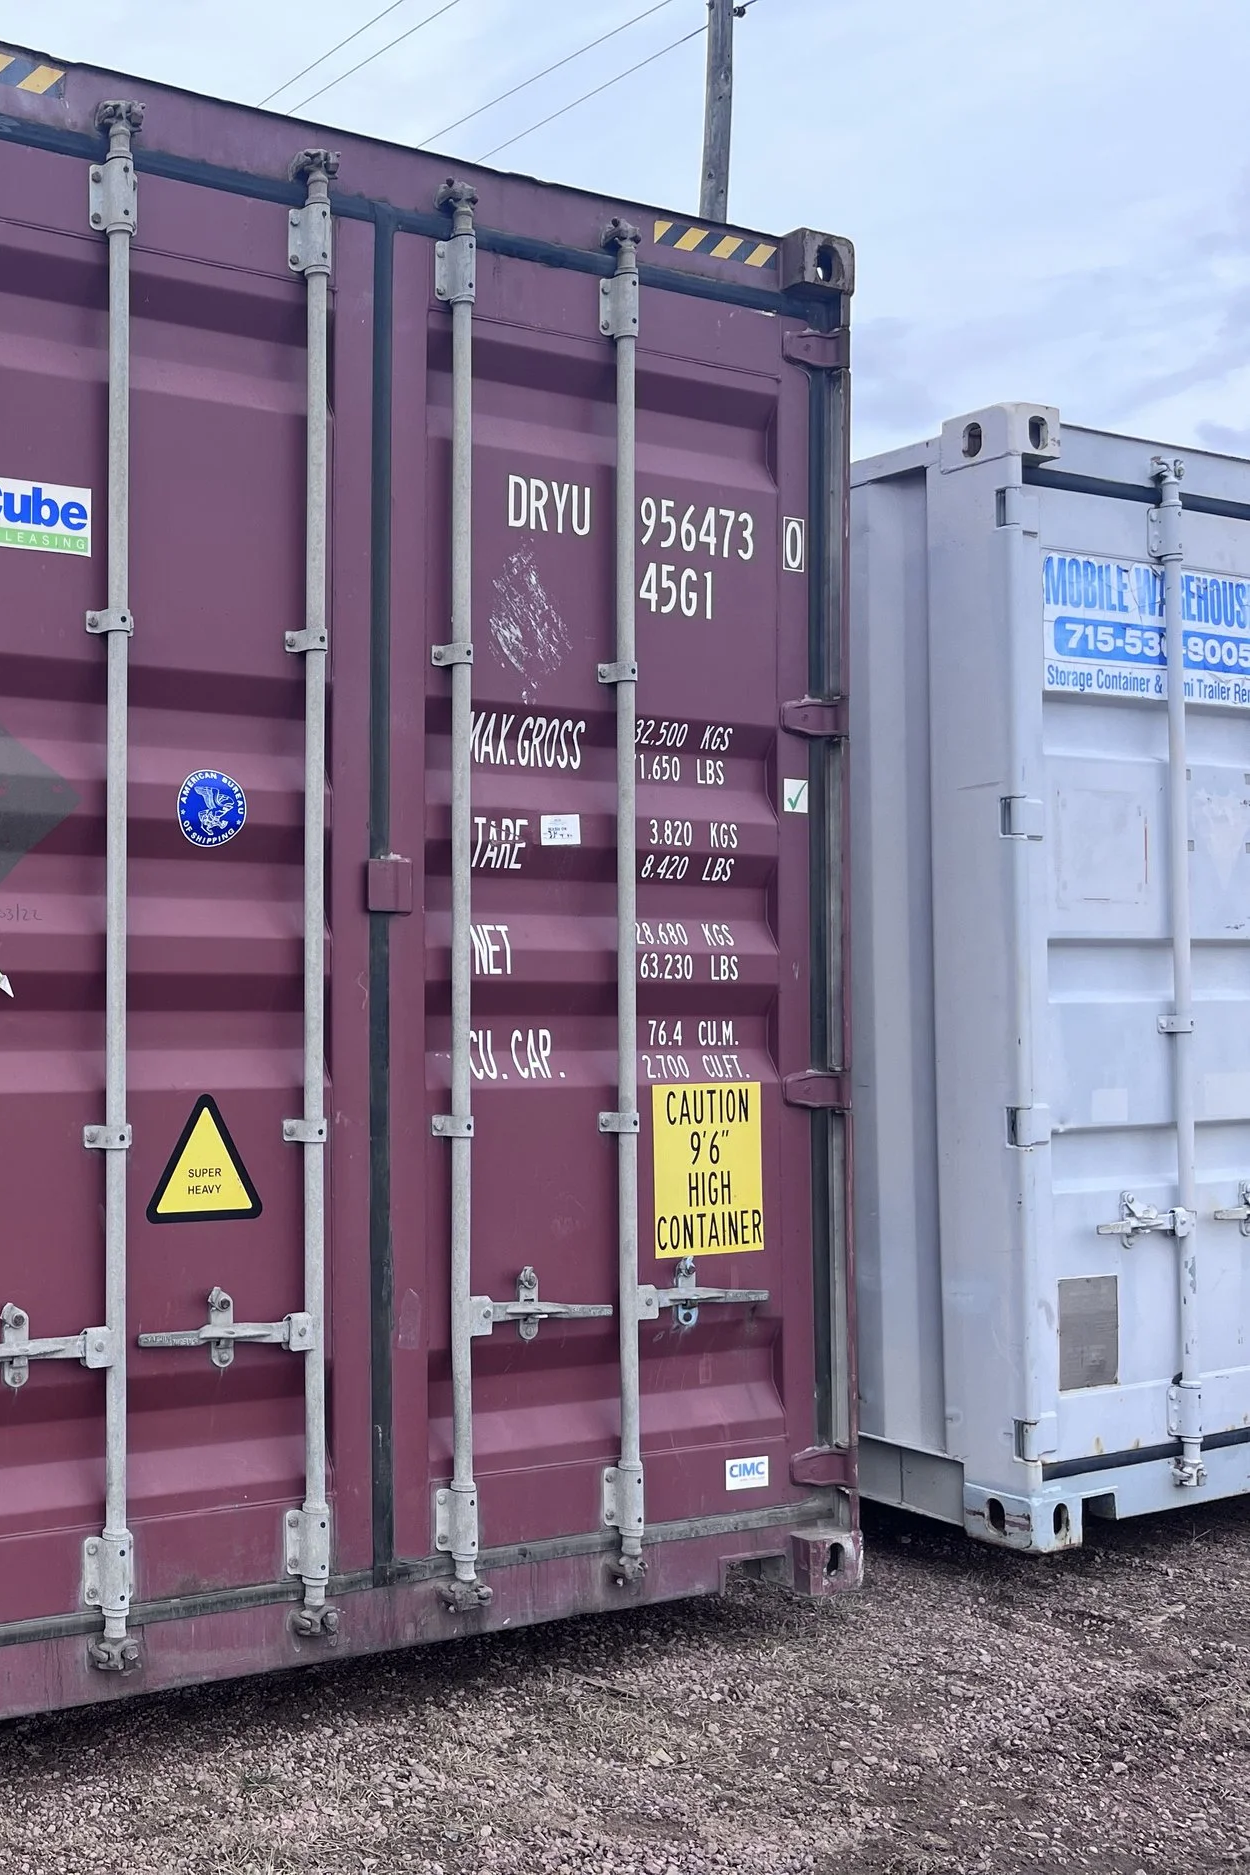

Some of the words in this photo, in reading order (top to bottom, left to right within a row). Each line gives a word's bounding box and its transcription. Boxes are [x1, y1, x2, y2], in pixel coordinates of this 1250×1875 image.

[508, 474, 591, 536] DRYU
[640, 497, 754, 560] 956473
[785, 520, 802, 568] 0
[5, 531, 86, 550] LEASING
[639, 562, 712, 620] 45G1
[1045, 556, 1129, 613] MOBILE
[1047, 664, 1092, 692] Storage
[1096, 668, 1150, 693] Container
[1154, 674, 1163, 694] &
[1196, 678, 1231, 701] Trailer
[700, 725, 733, 751] KGS
[634, 753, 680, 781] 1,650
[697, 758, 725, 785] LBS
[181, 772, 217, 804] AMERICAN
[221, 777, 244, 815] BUREAU
[183, 820, 193, 832] OF
[190, 828, 235, 844] SHIPPING
[471, 817, 528, 869] TARE
[710, 822, 738, 848] KGS
[702, 857, 735, 882] LBS
[470, 924, 512, 975] NET
[701, 923, 735, 947] KGS
[710, 955, 739, 981] LBS
[510, 1028, 566, 1079] CAP.
[648, 1020, 682, 1046] 76.4
[698, 1020, 739, 1046] CU.M.
[666, 1088, 749, 1125] CAUTION
[187, 1184, 222, 1195] HEAVY
[188, 1167, 222, 1178] SUPER
[688, 1170, 732, 1207] HIGH
[657, 1209, 762, 1251] CONTAINER
[729, 1461, 765, 1478] CIMC
